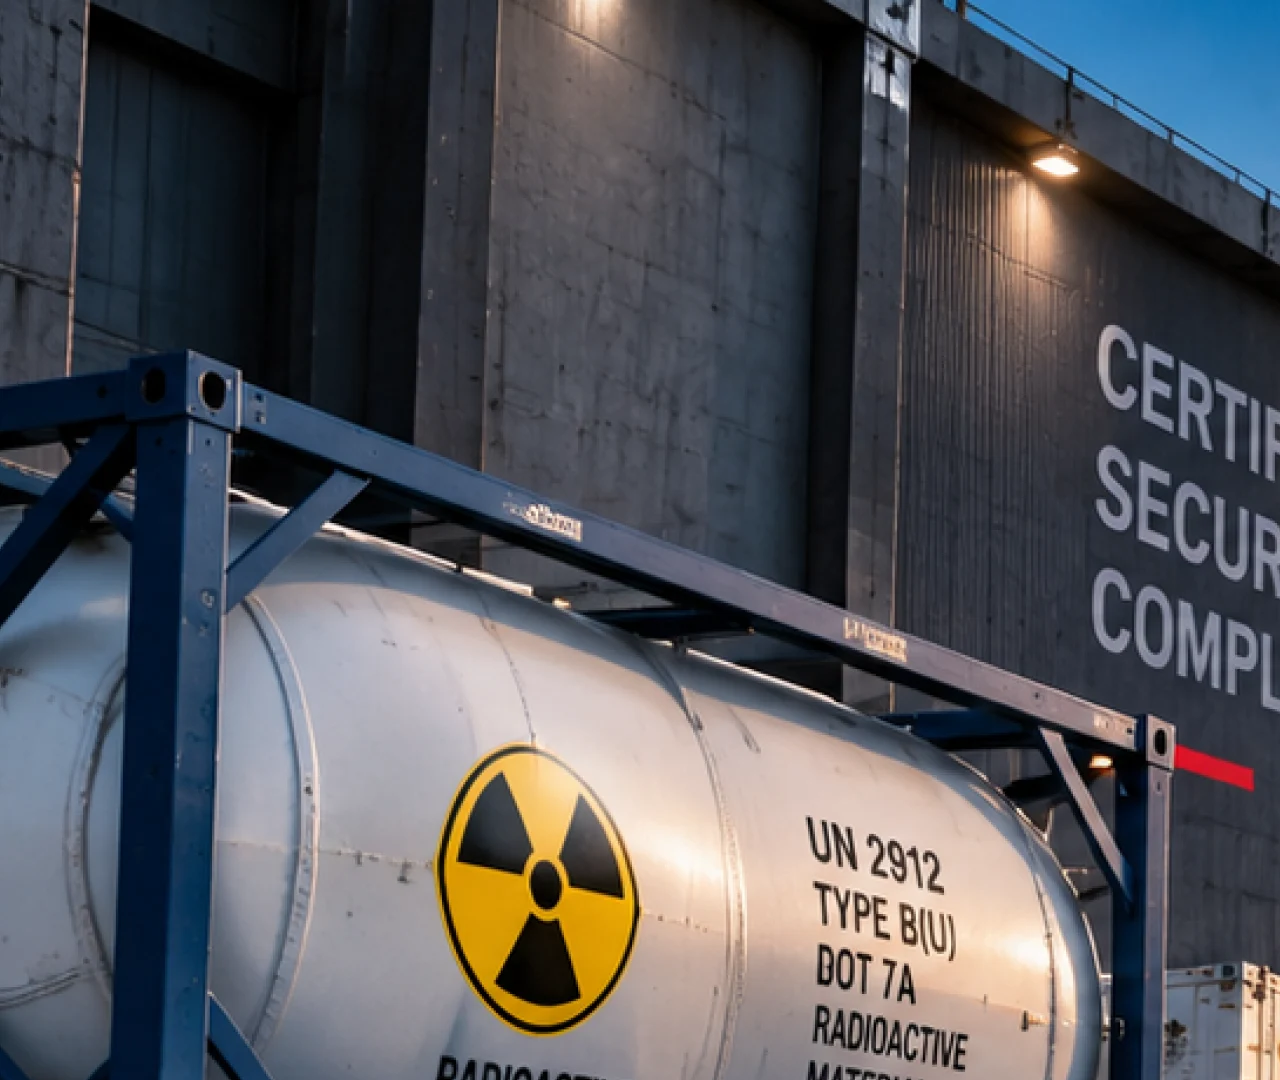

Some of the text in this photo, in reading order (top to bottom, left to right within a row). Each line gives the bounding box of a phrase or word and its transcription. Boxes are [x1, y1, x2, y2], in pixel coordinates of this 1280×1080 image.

[805, 816, 945, 896] UN 2912
[812, 879, 956, 962] TYPE B(U)
[882, 958, 917, 1005] 7A
[811, 1003, 969, 1073] RADIOACTIVE
